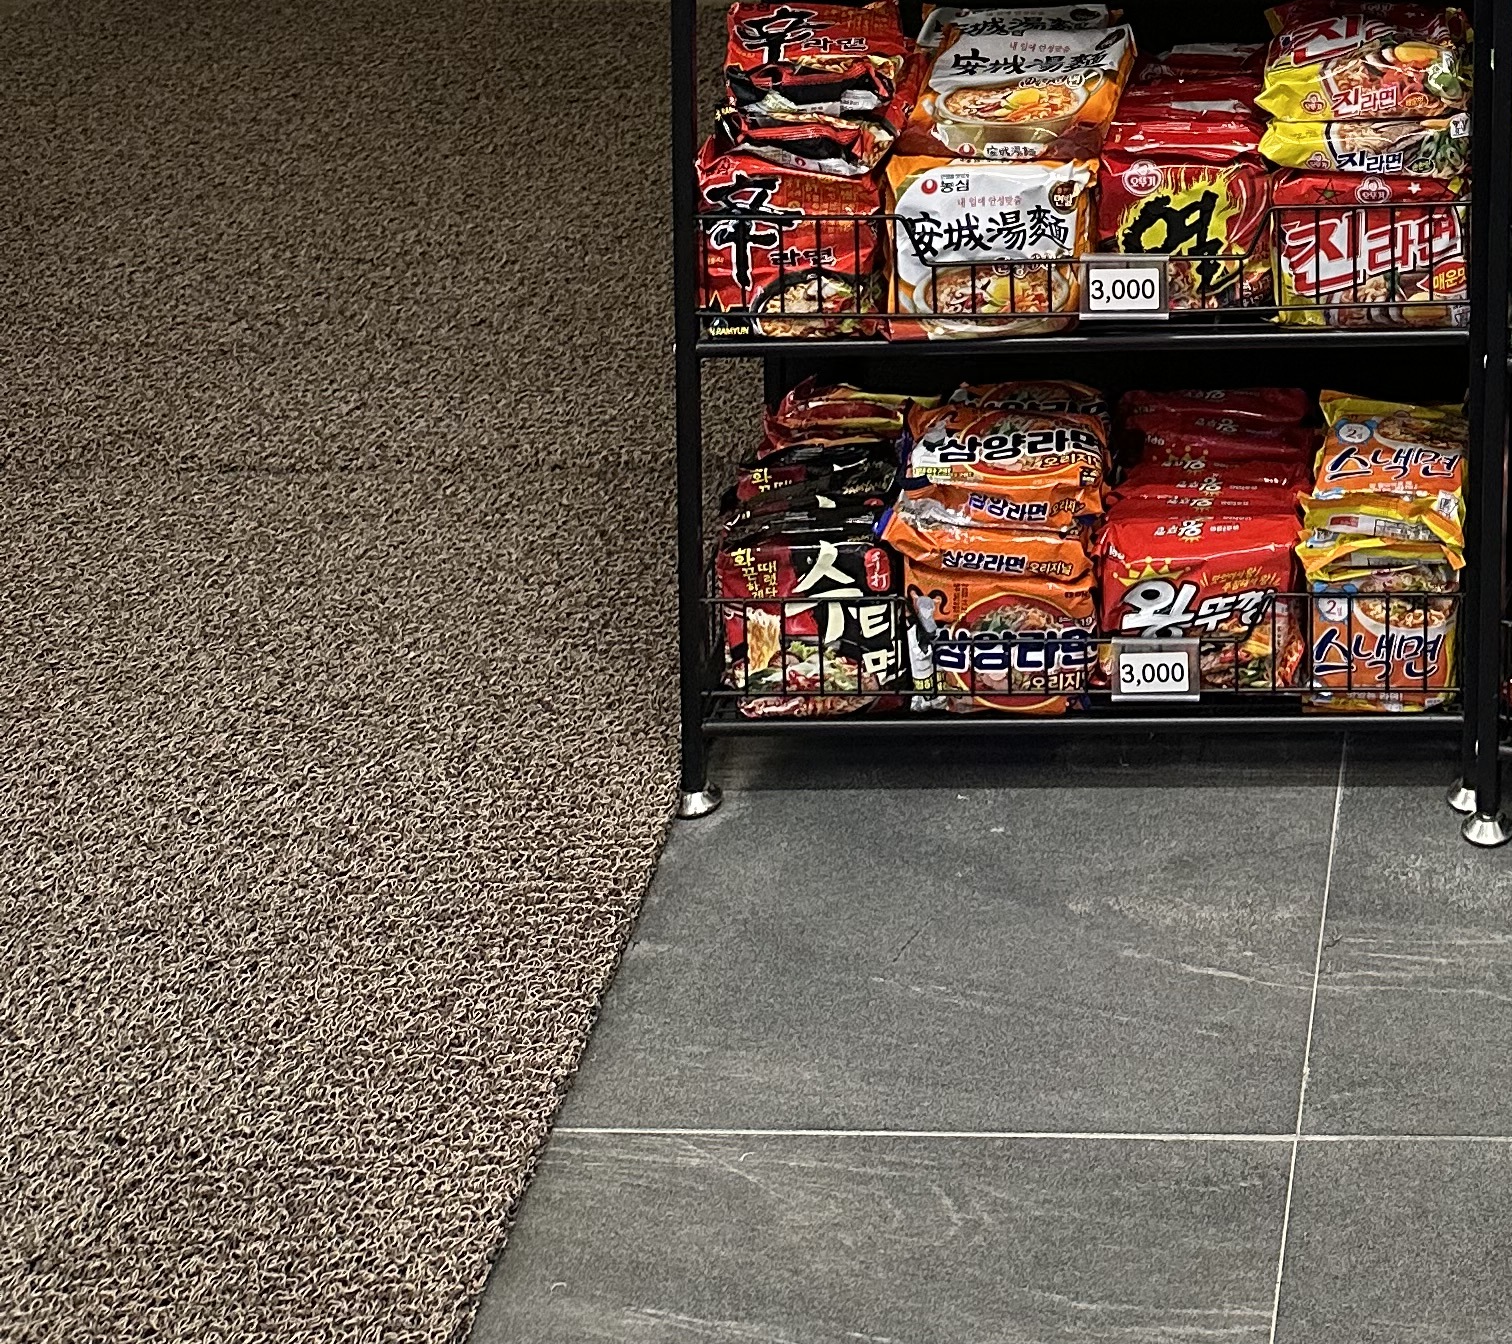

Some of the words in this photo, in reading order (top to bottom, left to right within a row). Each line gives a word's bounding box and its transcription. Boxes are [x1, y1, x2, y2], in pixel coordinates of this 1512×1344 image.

[736, 7, 833, 64] 辛
[803, 36, 868, 53] 라면
[1332, 87, 1398, 114] 진라면
[940, 179, 970, 193] 농심
[705, 172, 804, 291] 辛
[911, 204, 1076, 257] 安城湯麵
[1120, 188, 1226, 287] 열
[769, 247, 836, 266] 라면
[1285, 209, 1462, 298] 진라면
[1091, 278, 1156, 303] 3,000
[941, 428, 1101, 463] 삼양라면
[1327, 446, 1462, 480] 스낵면
[969, 493, 1049, 522] 삼양라면
[942, 550, 1027, 575] 삼양라면
[1029, 561, 1073, 577] 오리지널
[790, 540, 907, 686] 수타면
[1120, 578, 1277, 640] 왕뚜껑
[934, 628, 1098, 673] 삼양라면
[1312, 627, 1446, 682] 스낵면
[1121, 663, 1185, 686] 3,000
